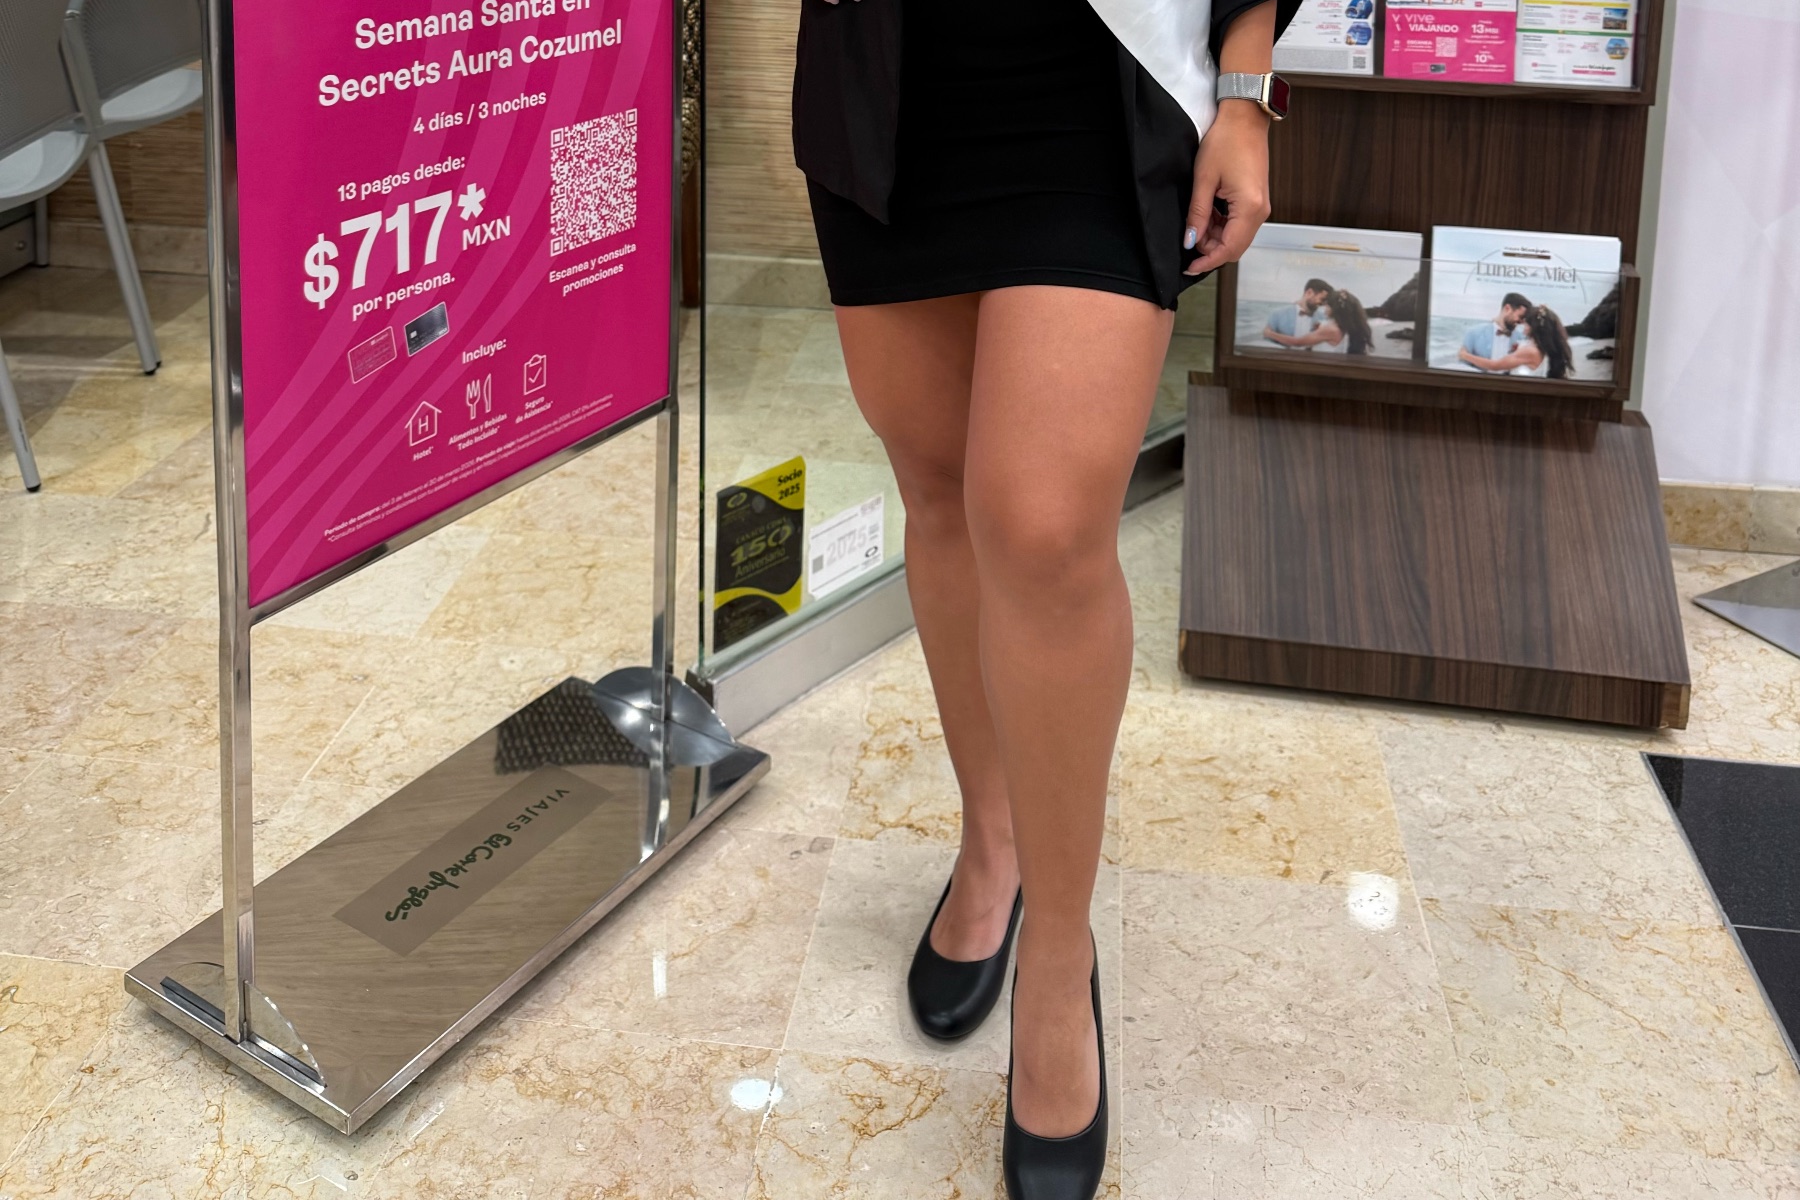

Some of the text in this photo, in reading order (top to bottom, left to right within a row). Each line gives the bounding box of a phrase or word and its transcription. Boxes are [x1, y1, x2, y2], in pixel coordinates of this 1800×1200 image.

[355, 8, 474, 49] Semana
[1409, 24, 1458, 32] VIAJANDO
[1471, 24, 1484, 34] 13
[319, 20, 622, 106] Secrets Aura Cozumel
[413, 91, 547, 135] 4 días / 3 noches
[338, 155, 466, 203] 13 pagos desde:
[462, 215, 511, 251] MXN
[549, 242, 637, 284] Escanea y consulta
[562, 263, 624, 297] promociones
[1476, 261, 1528, 278] Lunas
[1544, 266, 1577, 283] Miel
[352, 271, 456, 321] por persona.
[462, 339, 507, 364] Incluye:
[525, 397, 545, 410] Seguro
[449, 426, 479, 444] Alimentos
[484, 413, 507, 427] Bebidas
[777, 468, 803, 487] Socio
[777, 483, 801, 501] 2025
[507, 788, 570, 832] VIAJES
